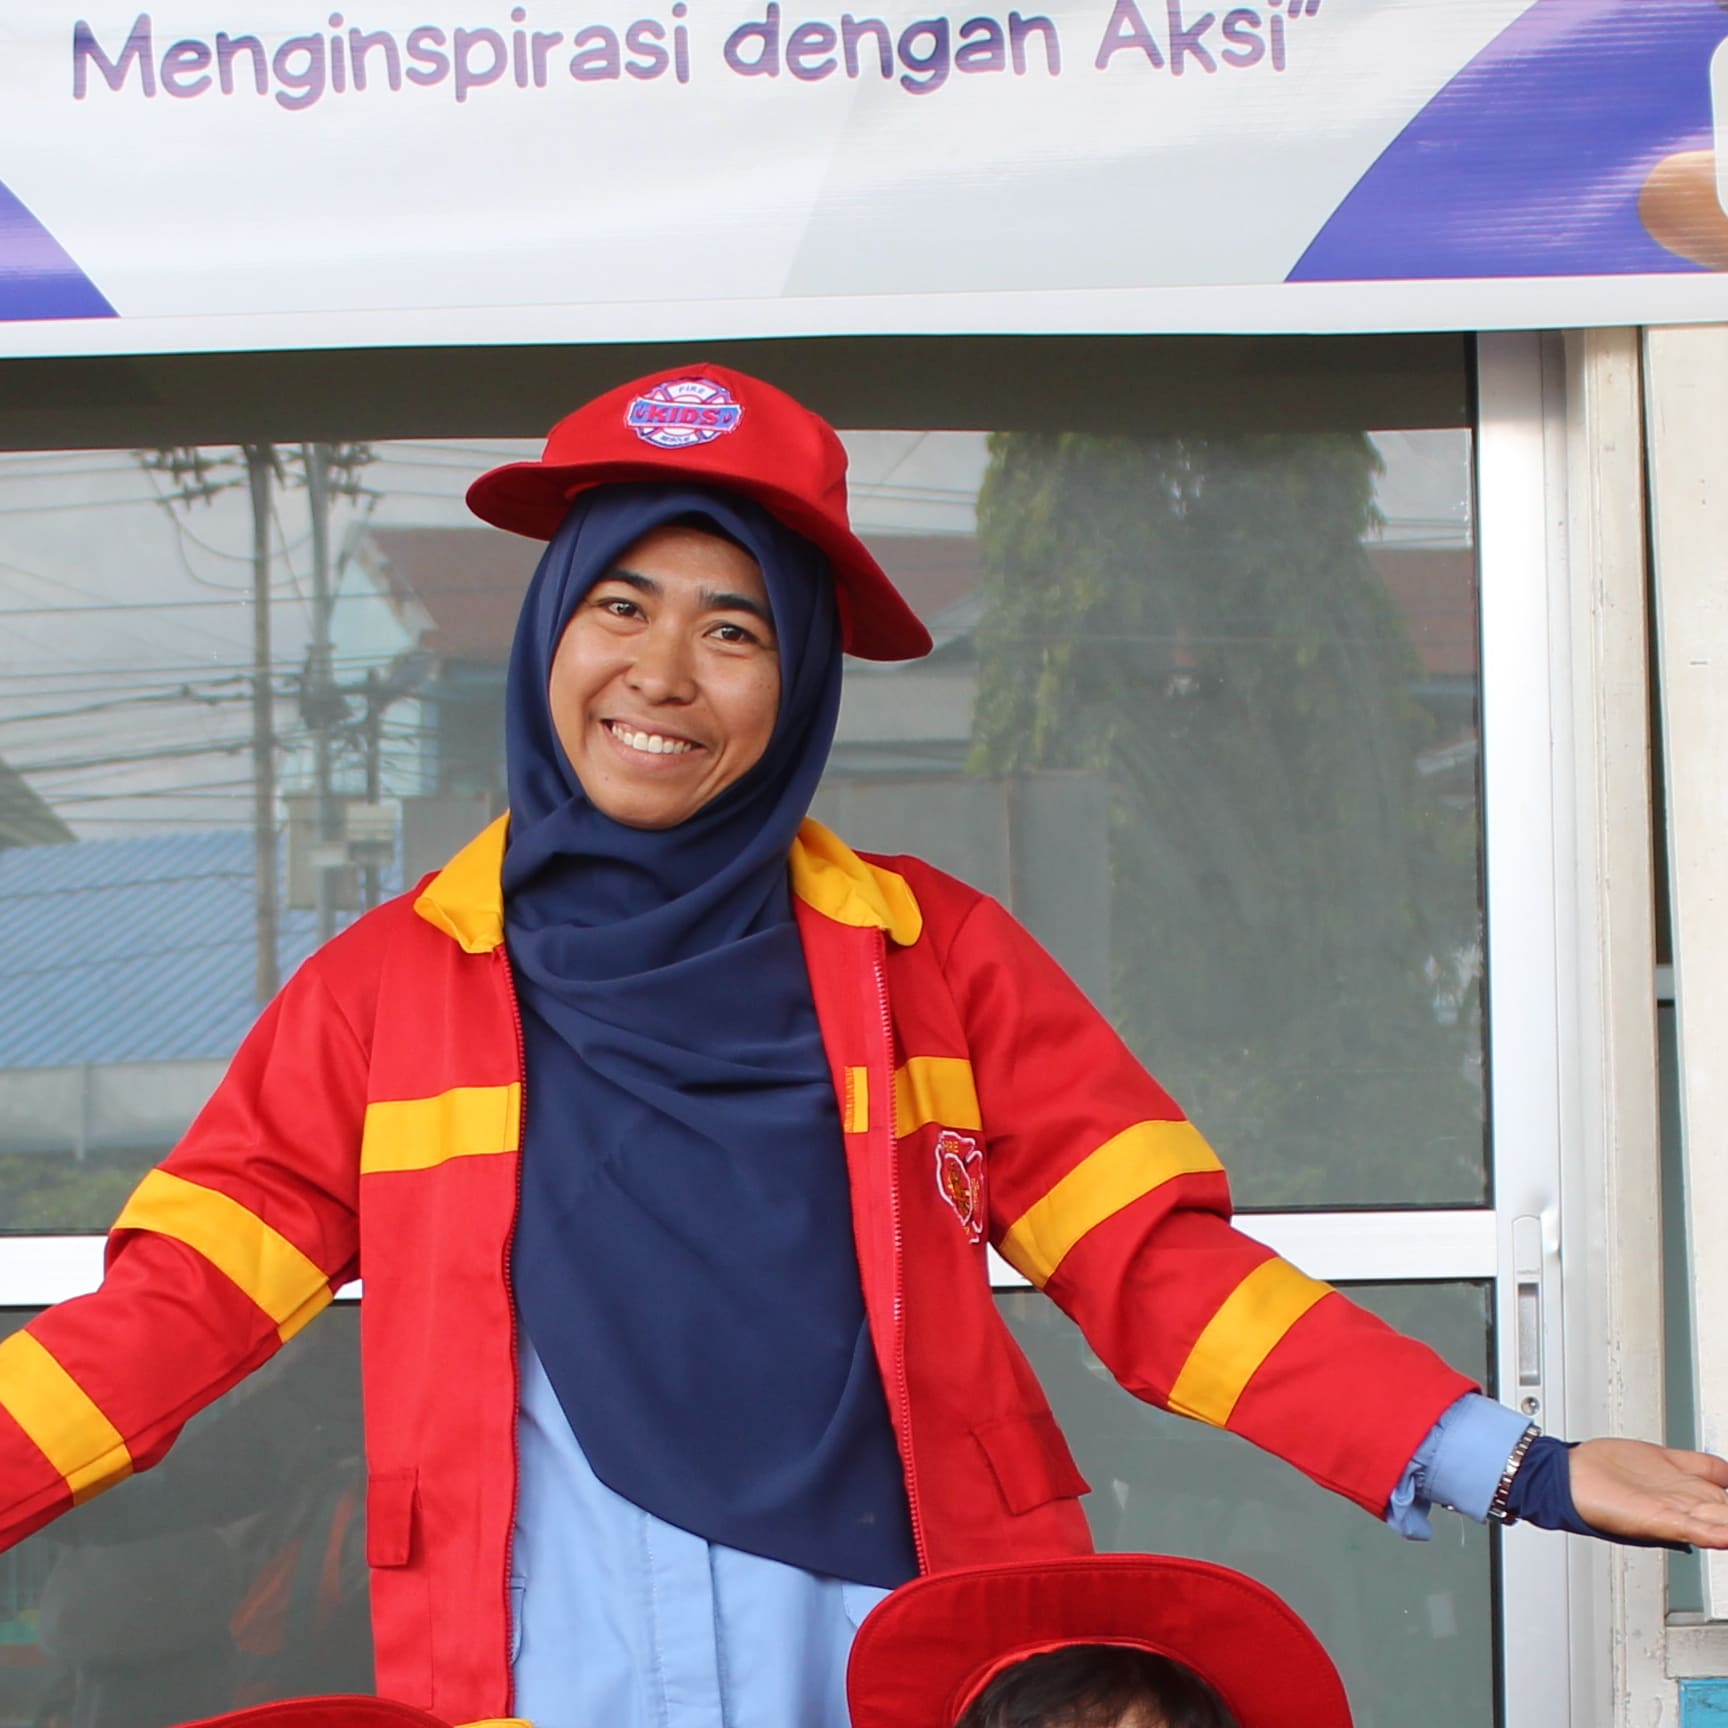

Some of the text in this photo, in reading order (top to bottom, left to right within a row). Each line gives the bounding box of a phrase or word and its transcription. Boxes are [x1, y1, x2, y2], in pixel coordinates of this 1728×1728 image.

[71, 3, 692, 112] Menginspirasi
[722, 1, 1064, 94] dengan
[647, 404, 720, 426] KIDS
